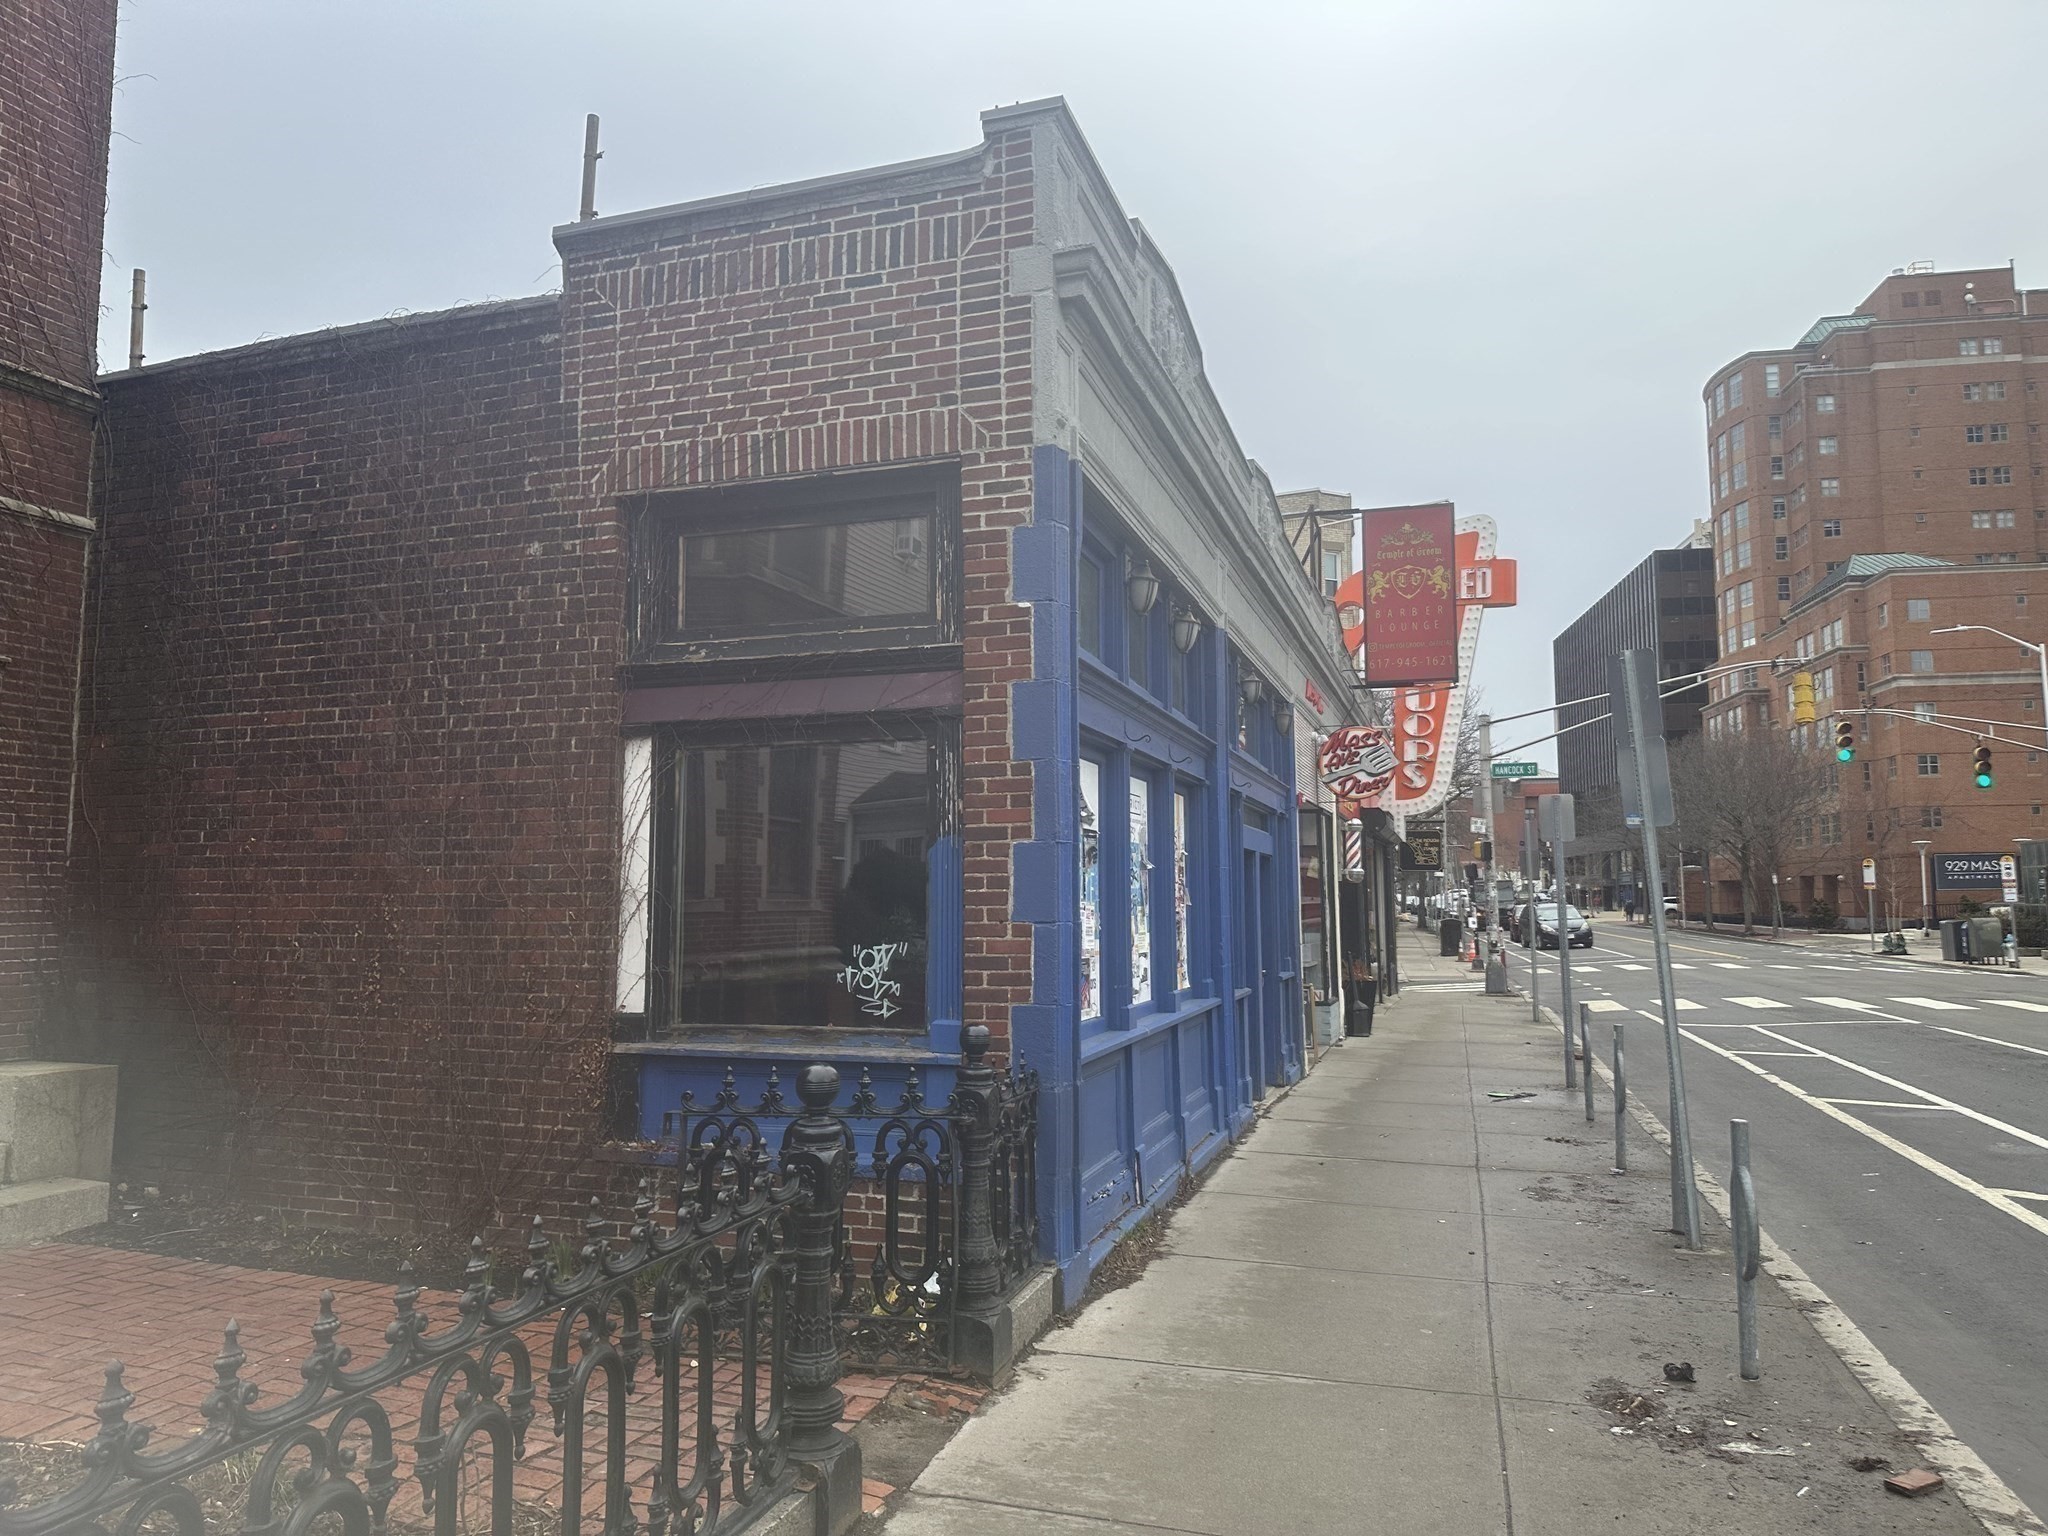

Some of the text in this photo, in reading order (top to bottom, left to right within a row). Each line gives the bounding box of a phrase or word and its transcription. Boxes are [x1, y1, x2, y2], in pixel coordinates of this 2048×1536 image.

[1376, 547, 1442, 560] Temple of Groom
[1375, 604, 1443, 619] BARBER
[1379, 619, 1440, 633] LOUNGE
[1369, 654, 1453, 669] 617-945-1621
[1322, 730, 1383, 756] Mass
[1494, 765, 1536, 775] HANCOCK ST
[1338, 774, 1389, 797] Diner
[1944, 860, 2001, 872] 929 MAS
